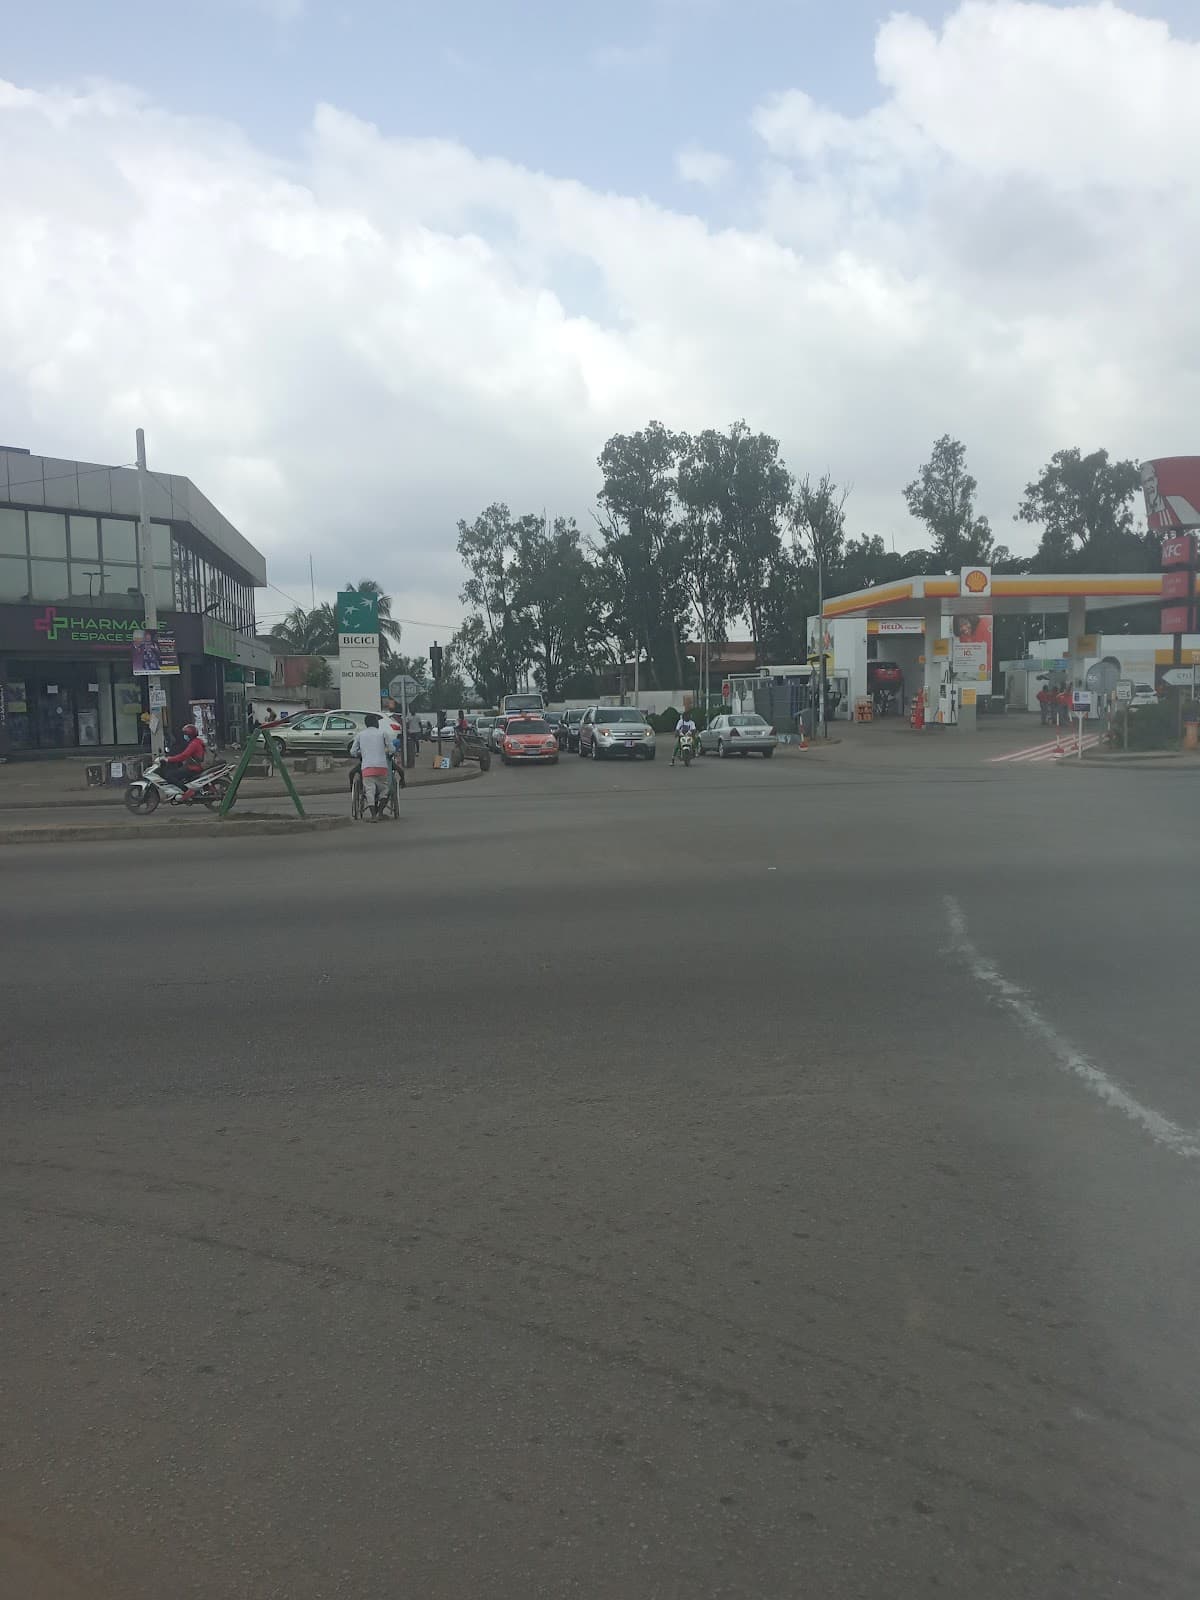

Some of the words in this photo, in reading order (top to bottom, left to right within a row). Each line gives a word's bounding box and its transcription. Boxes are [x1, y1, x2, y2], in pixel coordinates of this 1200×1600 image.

[1162, 543, 1182, 559] KFC
[71, 632, 123, 641] ESPACE
[343, 636, 375, 644] BICICI
